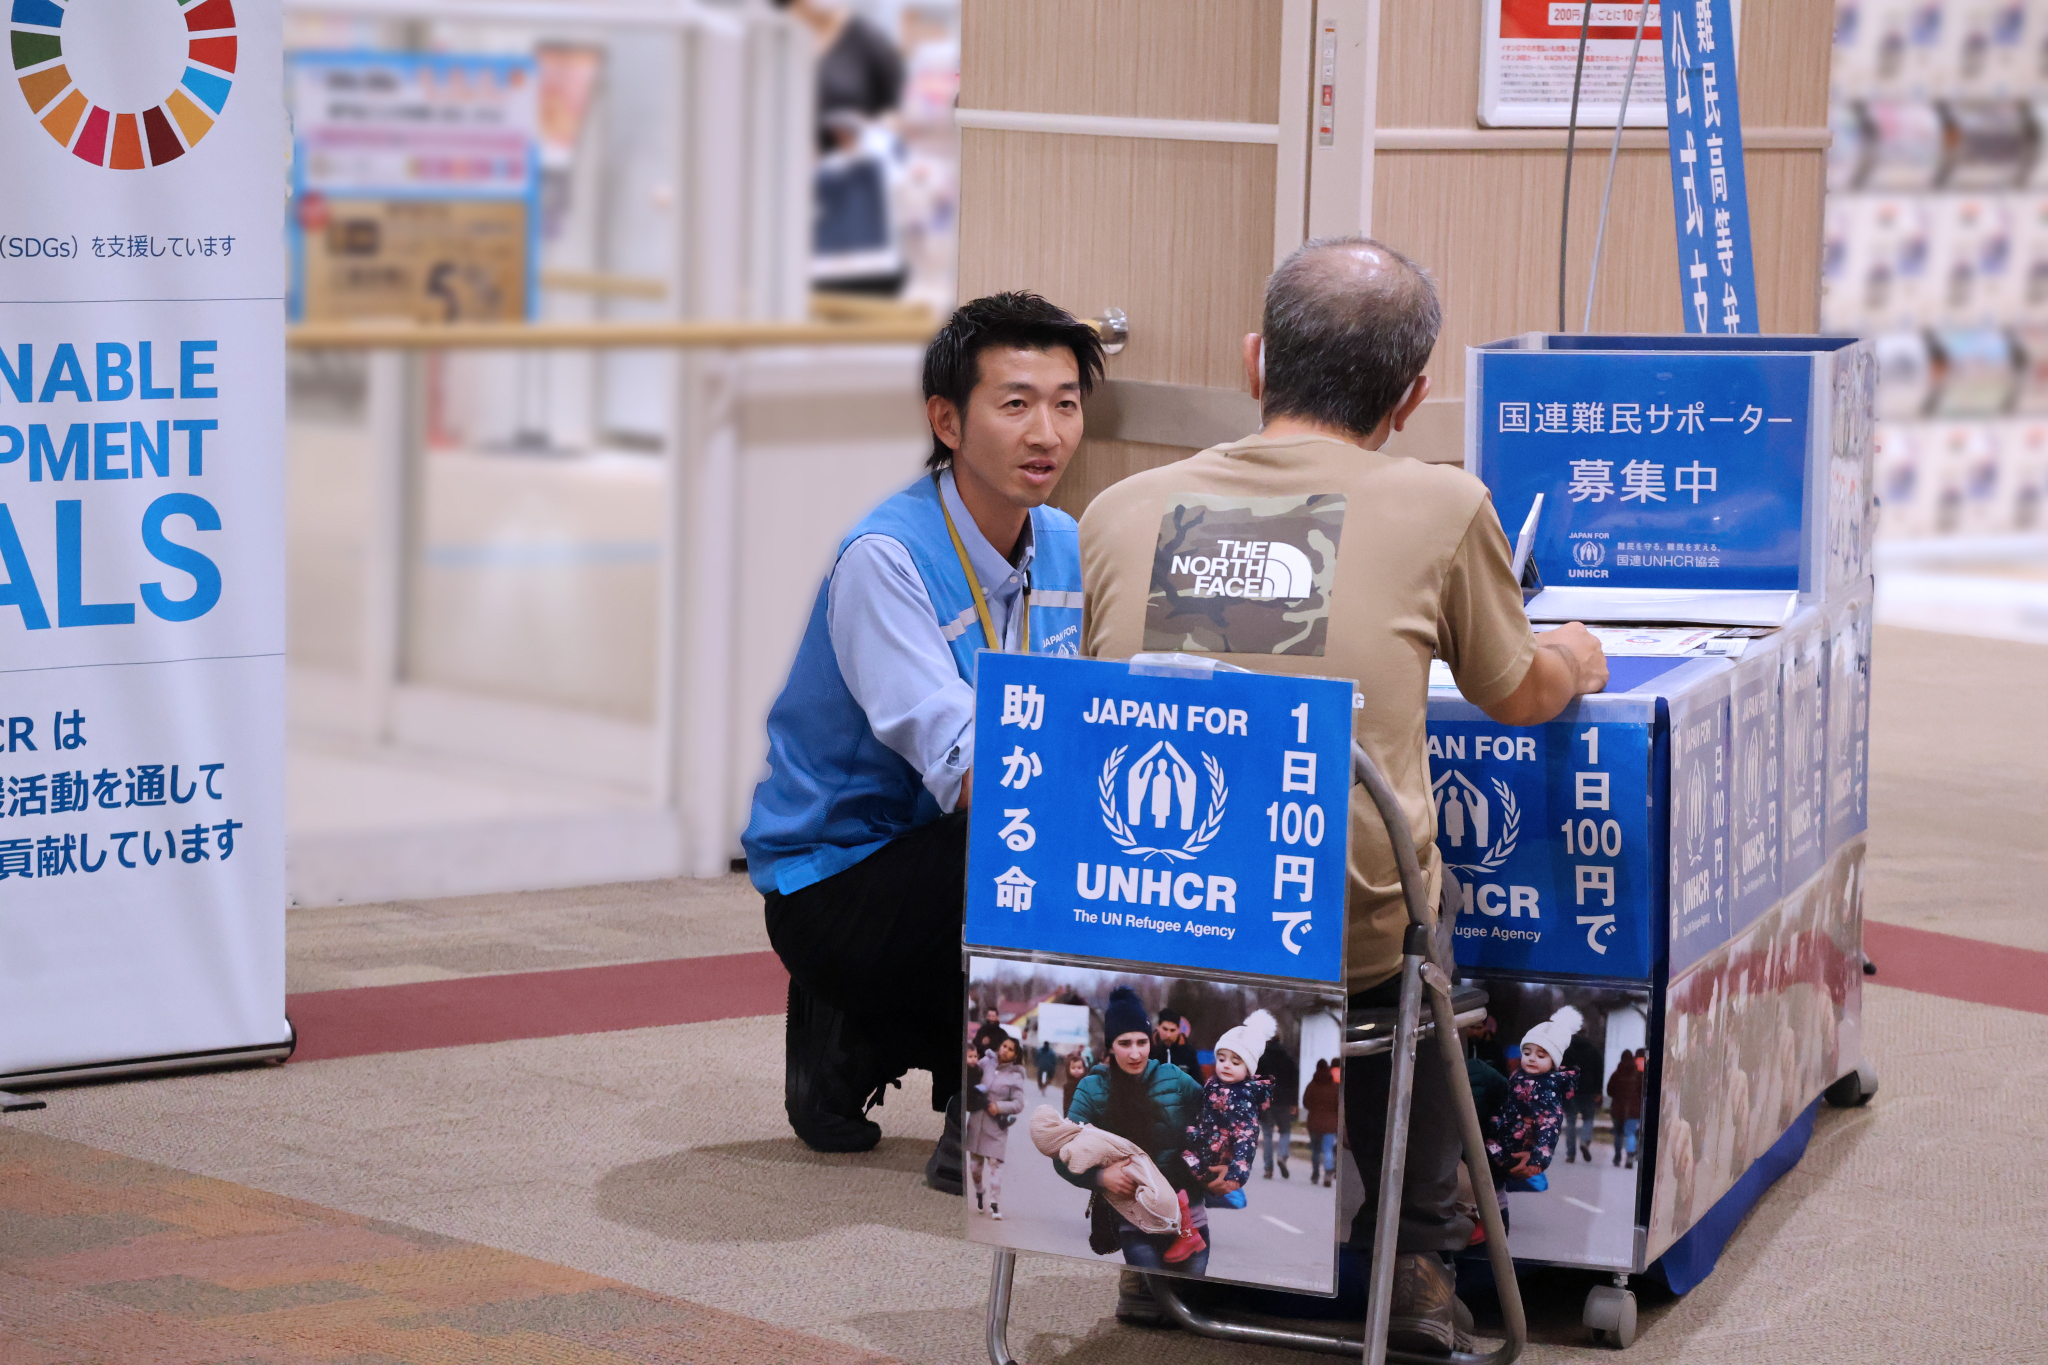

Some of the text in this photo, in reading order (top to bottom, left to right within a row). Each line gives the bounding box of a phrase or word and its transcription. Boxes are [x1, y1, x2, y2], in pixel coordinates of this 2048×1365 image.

[1498, 401, 1793, 435] 国連難民サポーター
[1567, 458, 1718, 504] 募集中
[1217, 539, 1269, 559] THE
[1616, 554, 1720, 568] 国連UNHCR協会
[1170, 555, 1265, 578] NORTH
[1568, 569, 1609, 578] UNHCR
[1193, 575, 1262, 598] FACE
[1042, 624, 1078, 649] JAPAN FOR
[1082, 697, 1249, 737] JAPAN FOR
[1475, 736, 1537, 762] FOR
[0, 763, 225, 818] 活動を通して
[993, 684, 1045, 913] 助かる命
[1266, 702, 1325, 956] 1日100円で
[1561, 726, 1622, 955] 1日100円で
[1742, 831, 1766, 876] UNHCR
[1076, 862, 1237, 914] UNHCR
[1683, 868, 1710, 916] UNHCR
[1073, 908, 1236, 940] The UN Refugee Agency
[1491, 926, 1542, 943] Agency
